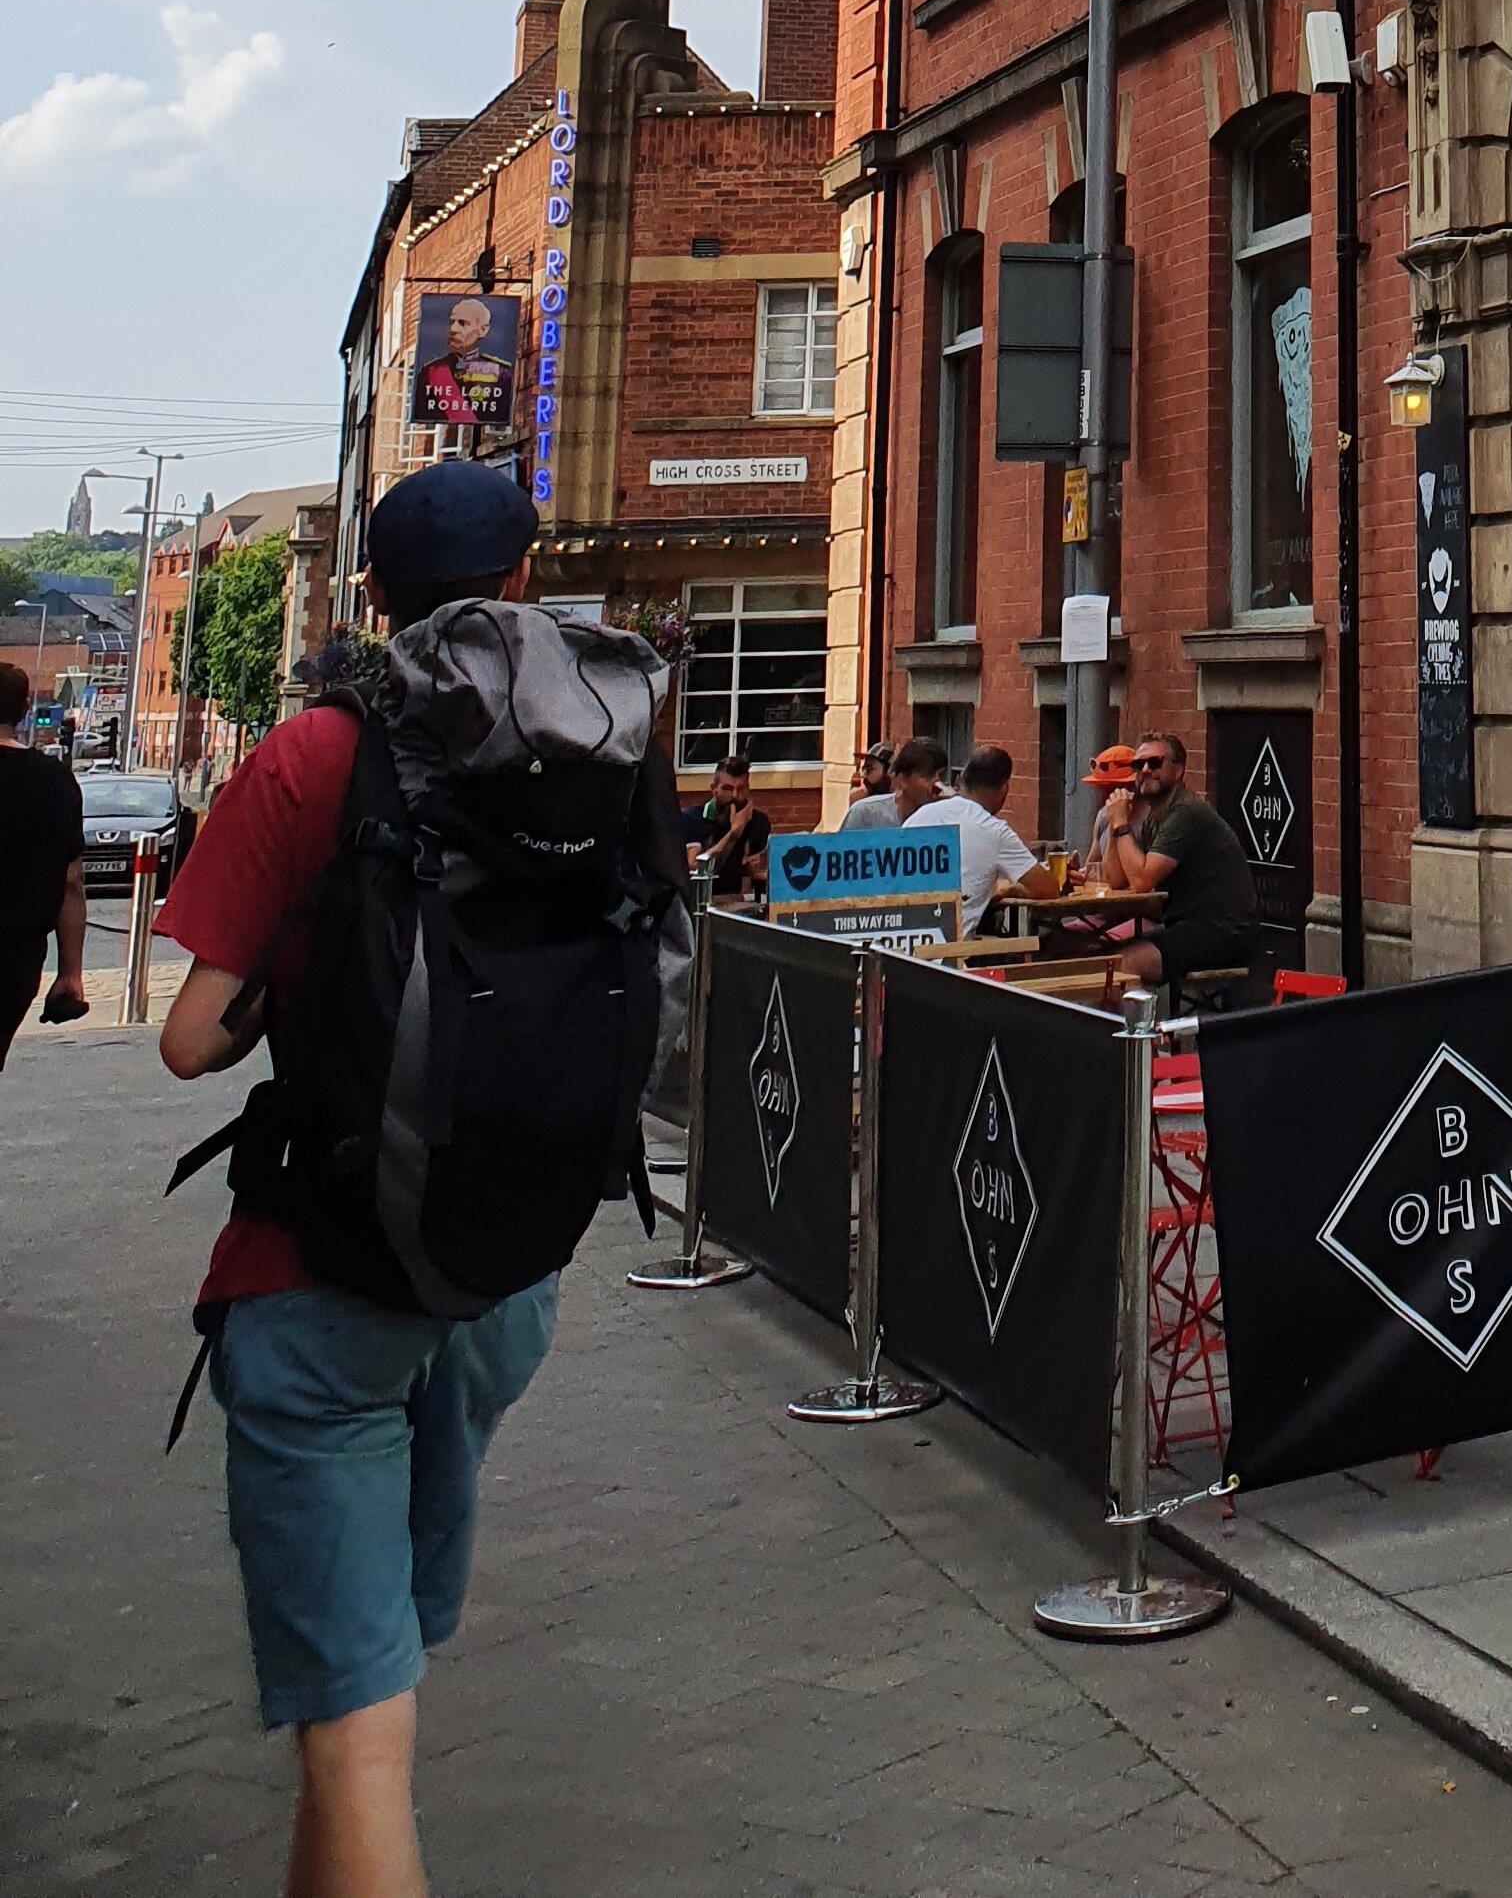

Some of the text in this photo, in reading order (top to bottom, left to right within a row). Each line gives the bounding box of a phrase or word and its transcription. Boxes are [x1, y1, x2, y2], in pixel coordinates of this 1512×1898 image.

[533, 88, 577, 502] LORD ROBERTS
[425, 385, 503, 399] THE LORD
[427, 399, 497, 413] ROBERTS
[655, 463, 801, 479] HIGH CROSS STREET
[1252, 795, 1282, 821] OHN
[826, 844, 950, 882] BREWDOG
[834, 913, 903, 931] THIS WAY FOR
[1435, 1105, 1468, 1158] B
[1446, 1259, 1476, 1314] S
